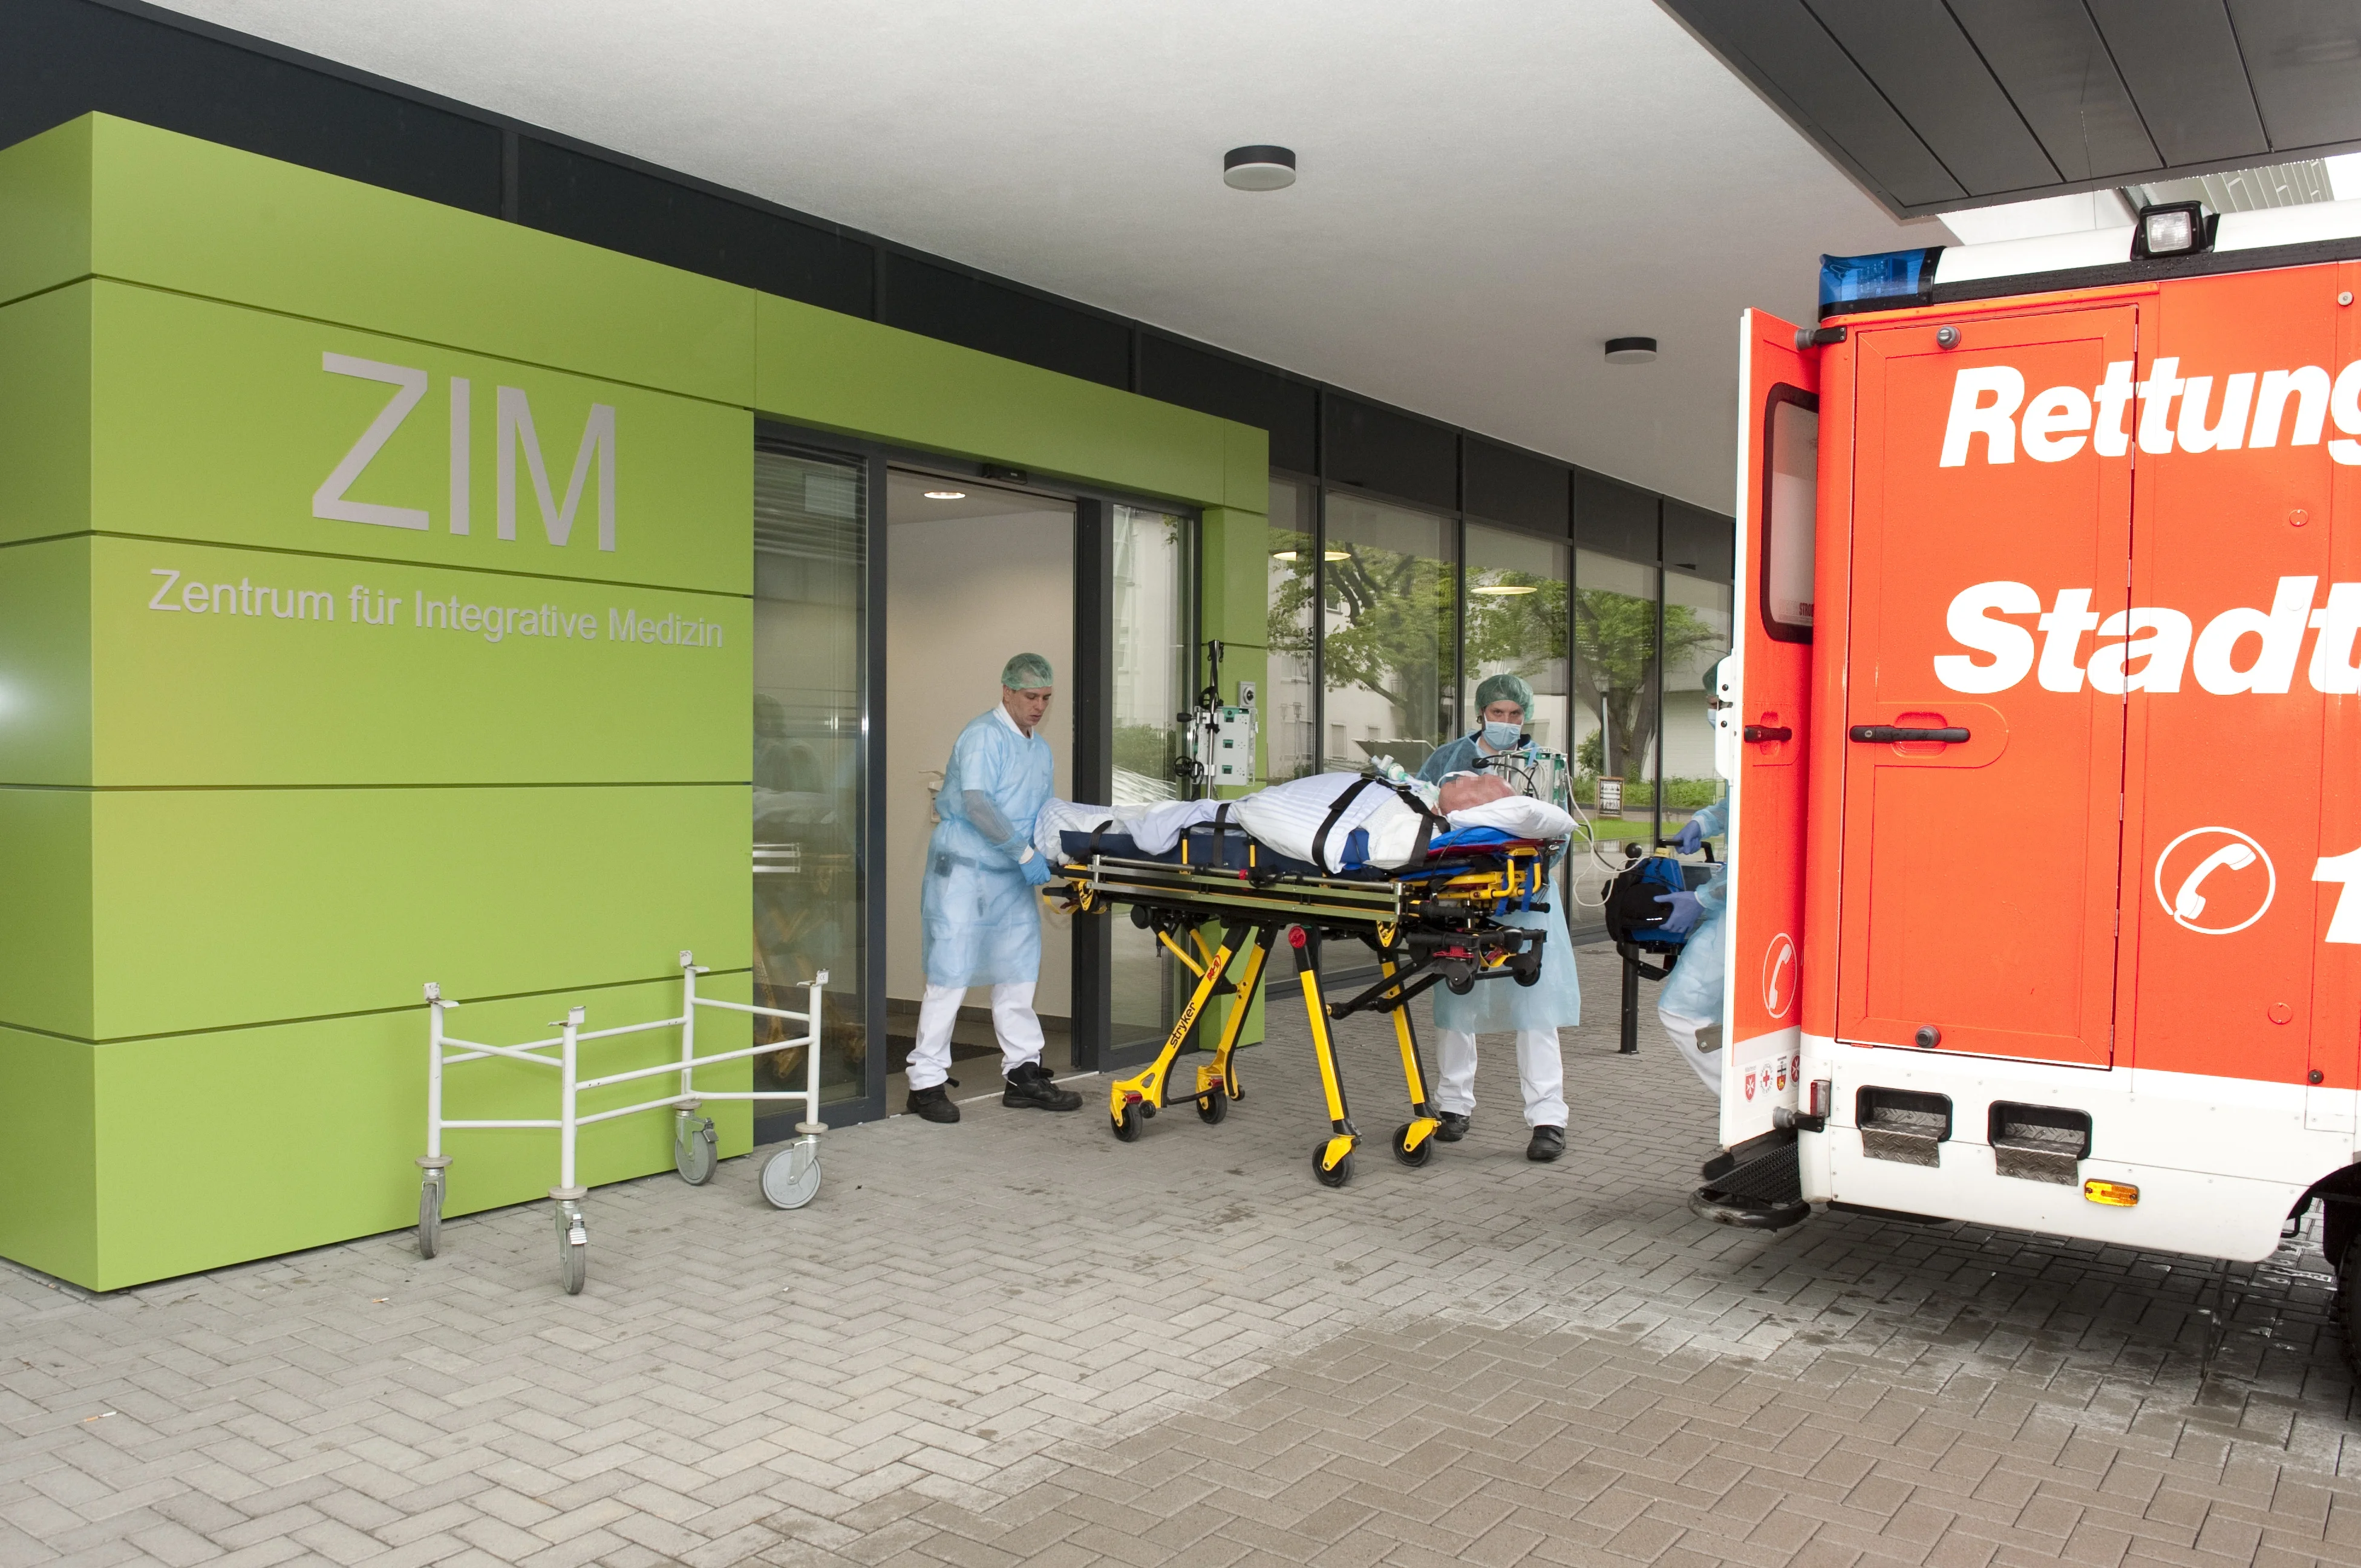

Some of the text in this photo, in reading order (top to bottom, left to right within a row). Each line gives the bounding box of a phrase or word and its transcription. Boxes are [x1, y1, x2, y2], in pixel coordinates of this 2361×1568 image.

[312, 351, 616, 552] ZIM
[149, 569, 723, 648] Zentrum für Integrative Medizin
[1934, 575, 2361, 702] Stadt
[1170, 1002, 1196, 1048] stryker
